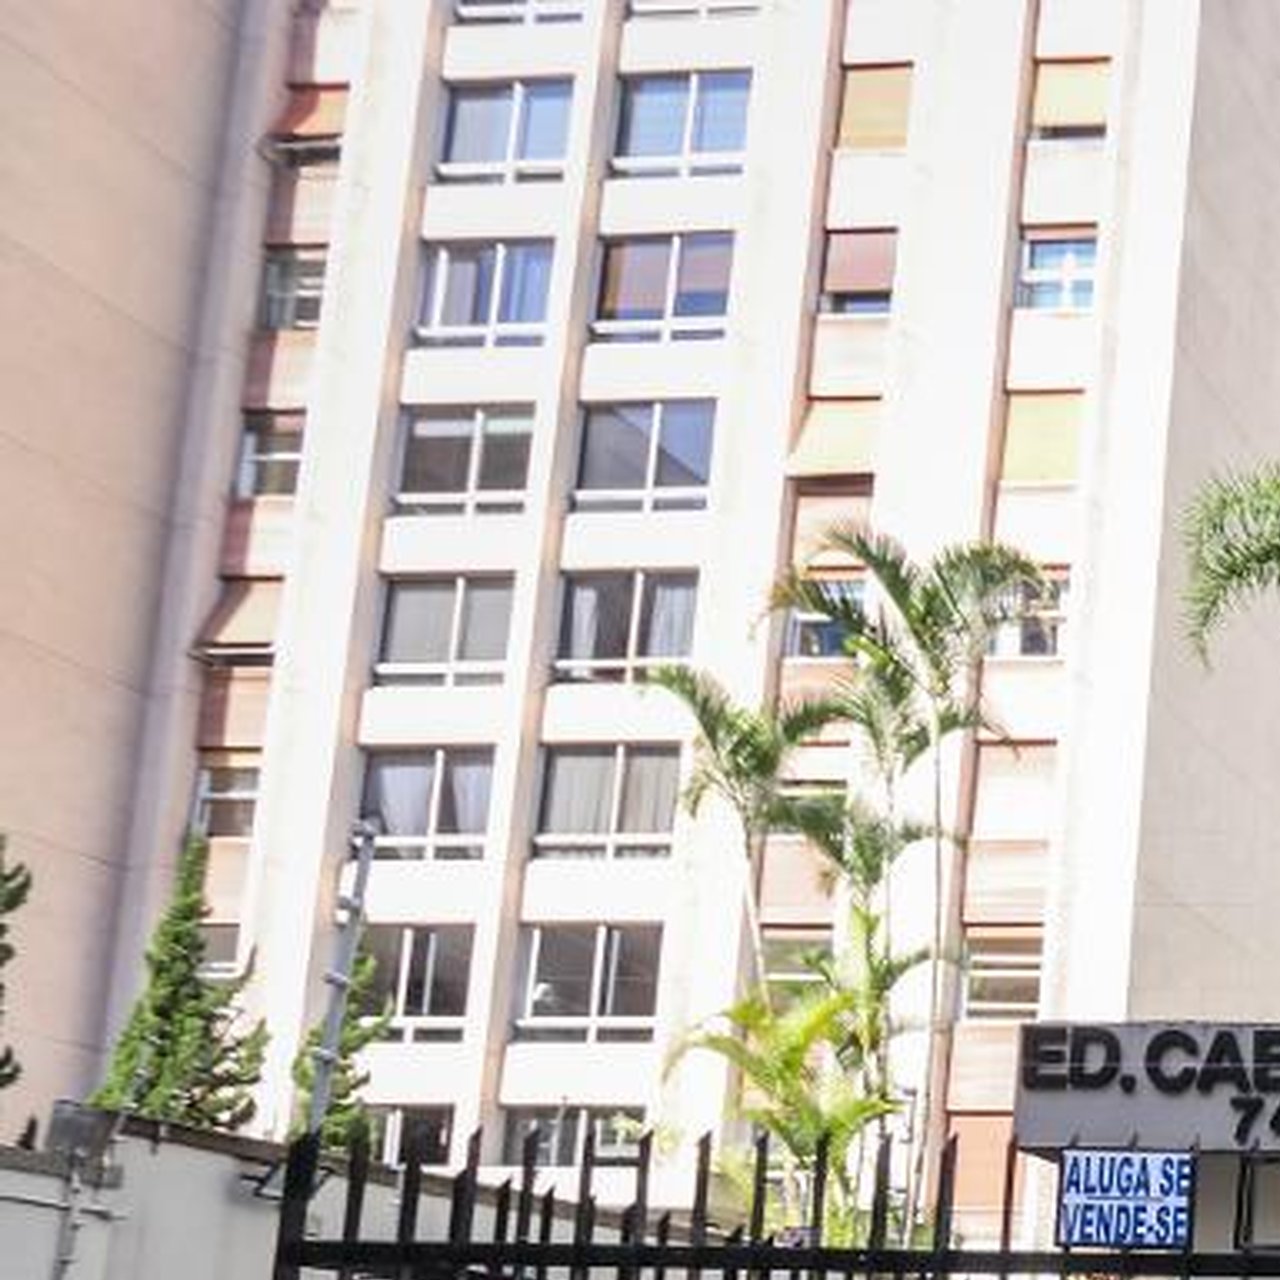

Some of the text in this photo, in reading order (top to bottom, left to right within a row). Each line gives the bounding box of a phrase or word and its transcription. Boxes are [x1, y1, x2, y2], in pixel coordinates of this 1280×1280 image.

[1066, 1156, 1192, 1197] ALUGA SE
[1062, 1203, 1189, 1244] VENDE-SE
